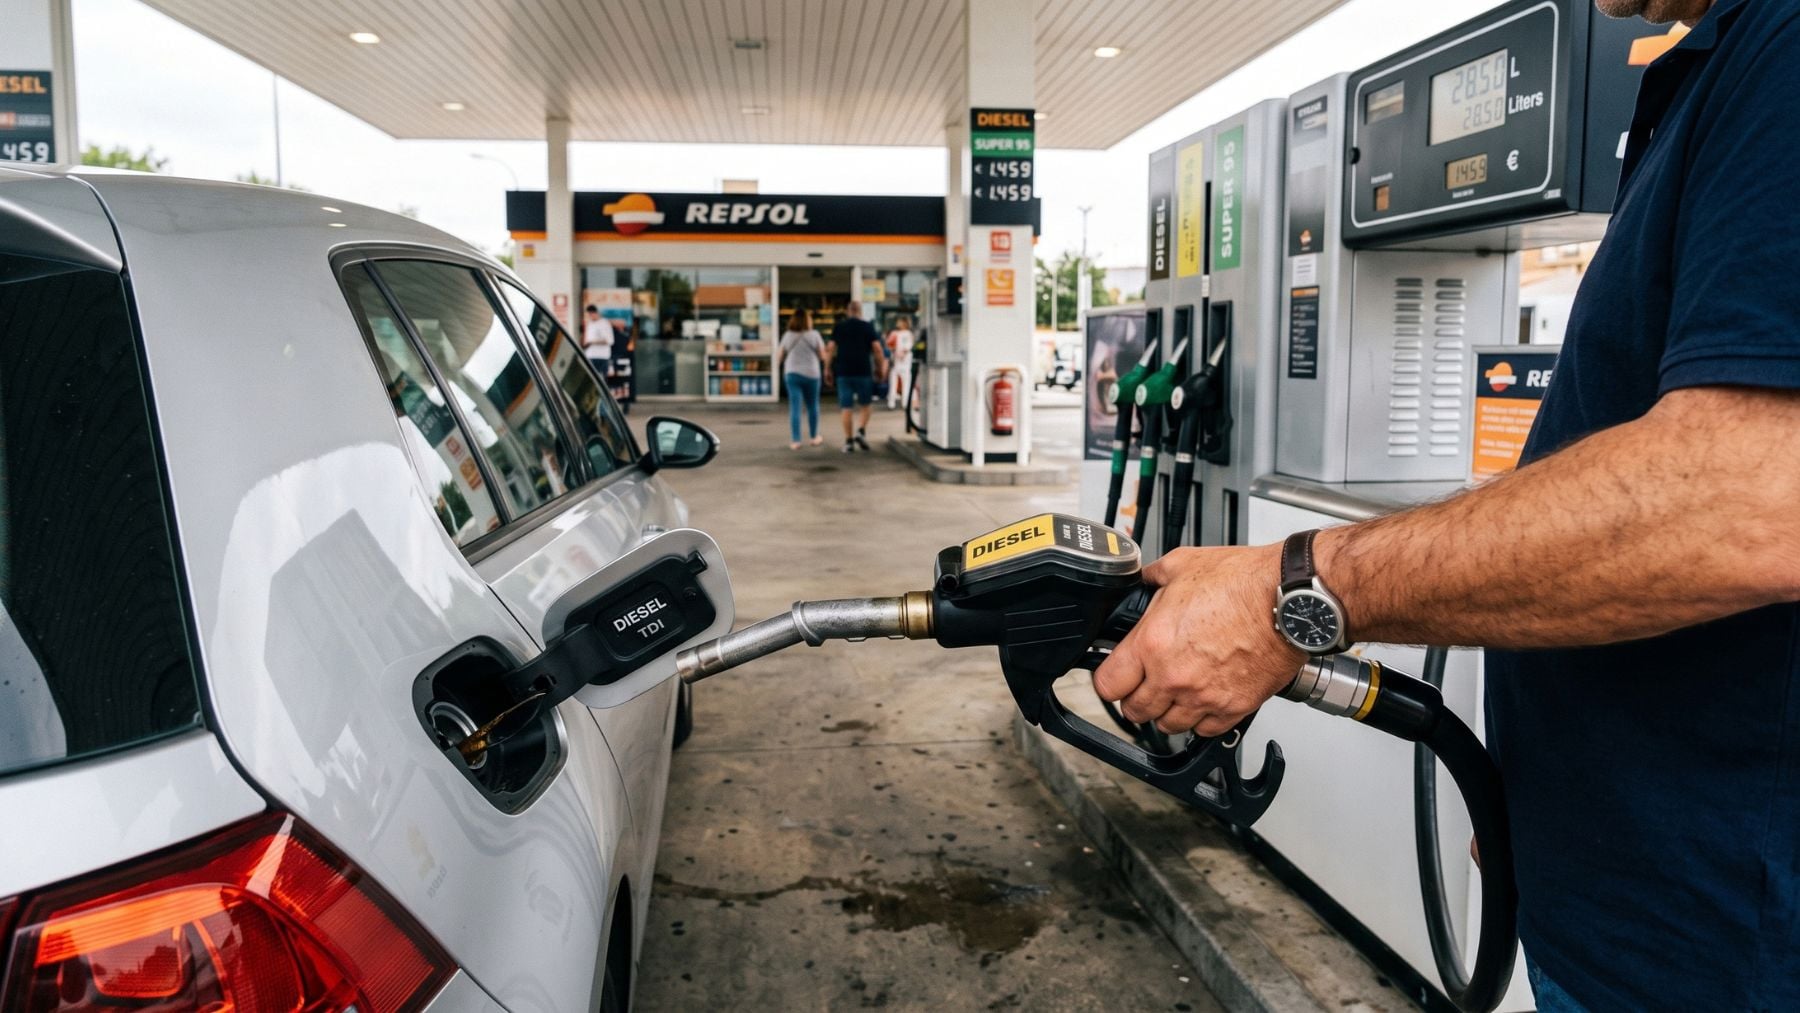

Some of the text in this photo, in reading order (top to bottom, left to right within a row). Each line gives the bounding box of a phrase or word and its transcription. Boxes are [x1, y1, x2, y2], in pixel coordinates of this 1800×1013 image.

[1510, 56, 1520, 78] L
[1508, 91, 1543, 114] Liters
[977, 113, 1030, 127] DIESEL
[974, 138, 1031, 151] SUPER 95
[1506, 149, 1519, 171] €
[1221, 141, 1235, 258] SUPER 95
[685, 203, 809, 225] REPSOL
[1155, 198, 1166, 271] DIESEL
[972, 526, 1046, 559] DIESEL
[1077, 524, 1094, 551] DIESEL
[612, 597, 668, 632] DIESEL
[637, 618, 665, 638] TDI
